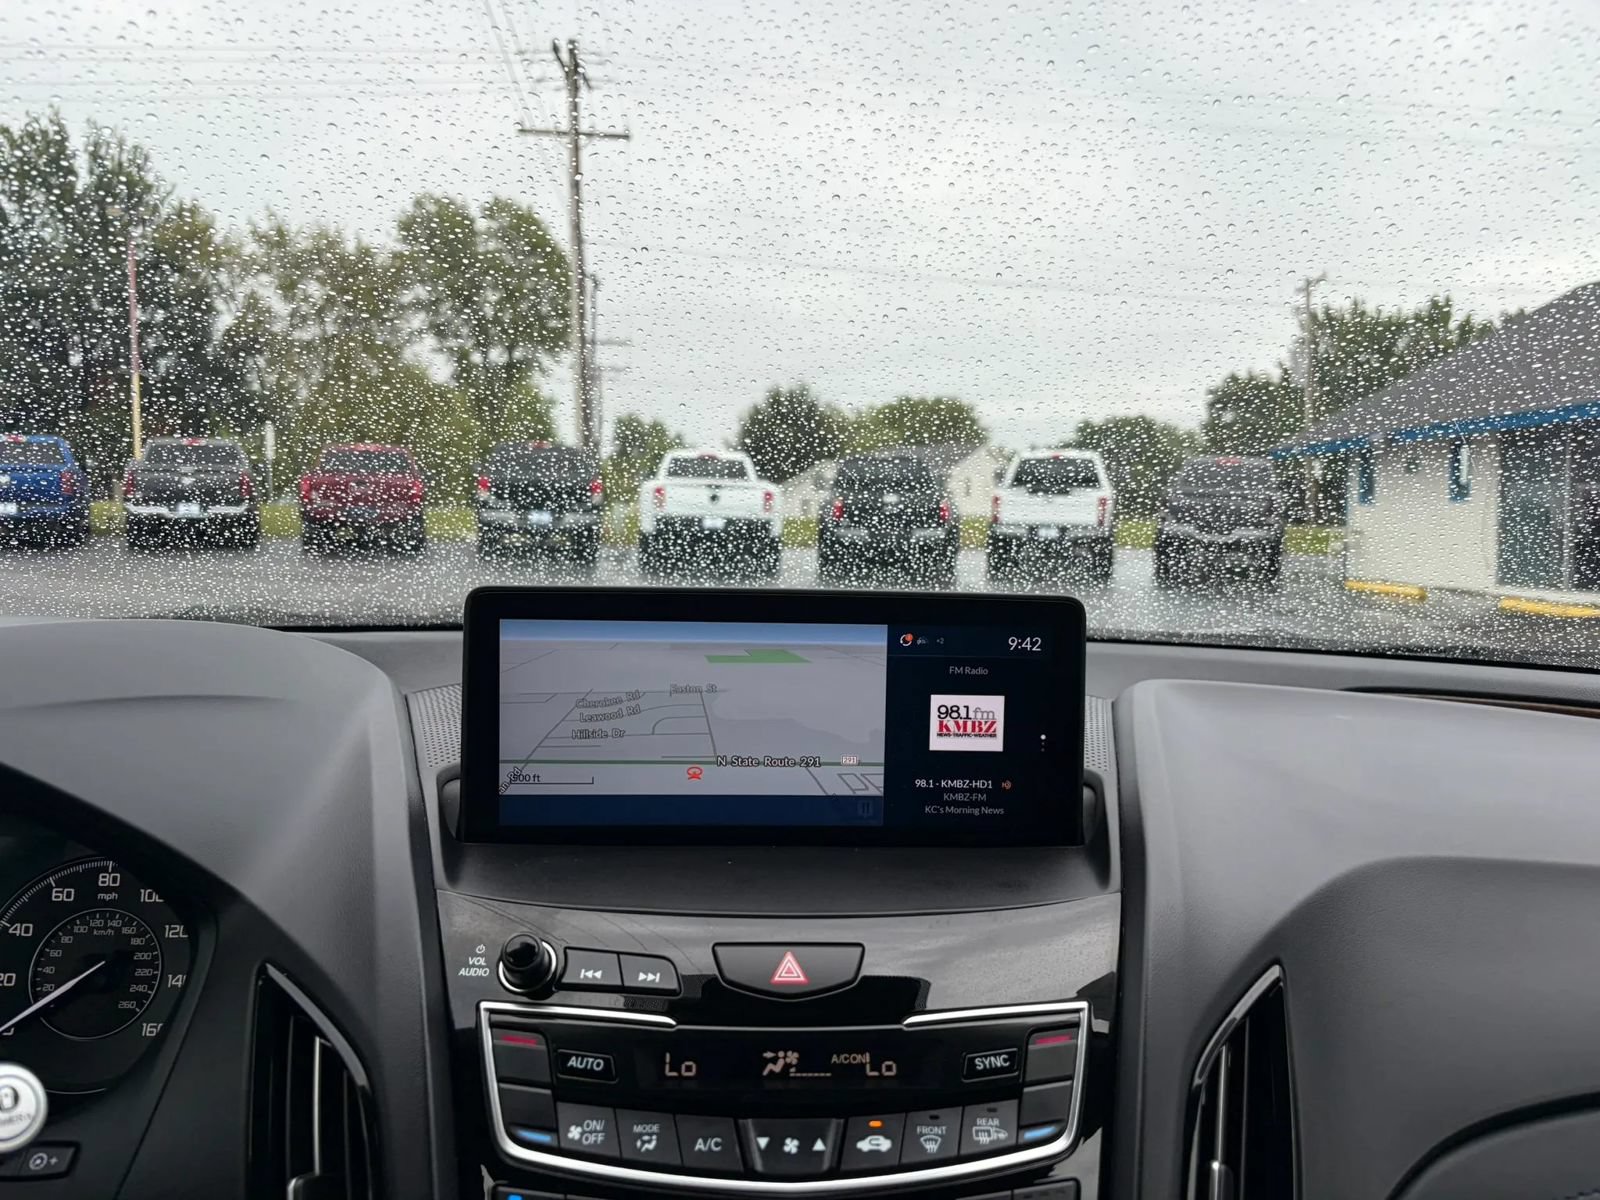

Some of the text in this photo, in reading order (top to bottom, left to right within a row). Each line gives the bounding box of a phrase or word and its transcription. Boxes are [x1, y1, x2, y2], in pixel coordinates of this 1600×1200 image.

[1008, 636, 1042, 652] 9:42
[949, 666, 988, 675] FM Radio
[705, 683, 718, 694] St
[576, 690, 641, 709] Cherokee Rd
[580, 704, 641, 723] Leawood Rd
[937, 704, 996, 720] 98.1 fm
[938, 719, 997, 733] KMBZ
[572, 728, 626, 739] Hillside Dr
[717, 755, 821, 768] N State Route 291
[507, 766, 522, 781] Rd
[532, 774, 541, 782] ft
[915, 779, 934, 788] 98.1
[941, 779, 993, 789] KMBZ-HD1
[943, 792, 987, 801] KMBZ-FM
[924, 805, 1005, 816] KC's Morning News
[98, 873, 120, 887] 80
[51, 888, 75, 902] 60
[97, 892, 118, 901] mph
[89, 919, 104, 927] 120
[107, 919, 122, 927] 140
[8, 923, 33, 937] 40
[121, 927, 137, 935] 160
[61, 936, 73, 944] 80
[130, 937, 146, 945] 180
[49, 949, 62, 957] 60
[133, 952, 152, 960] 200
[467, 956, 487, 966] VOL
[42, 966, 55, 974] 40
[458, 967, 490, 977] AUDIO
[167, 974, 187, 988] 14
[42, 984, 55, 992] 20
[129, 984, 148, 993] 240
[118, 1001, 137, 1009] 260
[567, 1055, 605, 1072] AUTO
[974, 1055, 1011, 1071] SYNC
[583, 1119, 605, 1132] ON/
[976, 1117, 1000, 1128] REAR
[633, 1123, 660, 1134] MODE
[916, 1125, 947, 1136] FRONT
[582, 1133, 606, 1145] OFF
[694, 1137, 722, 1151] A/C
